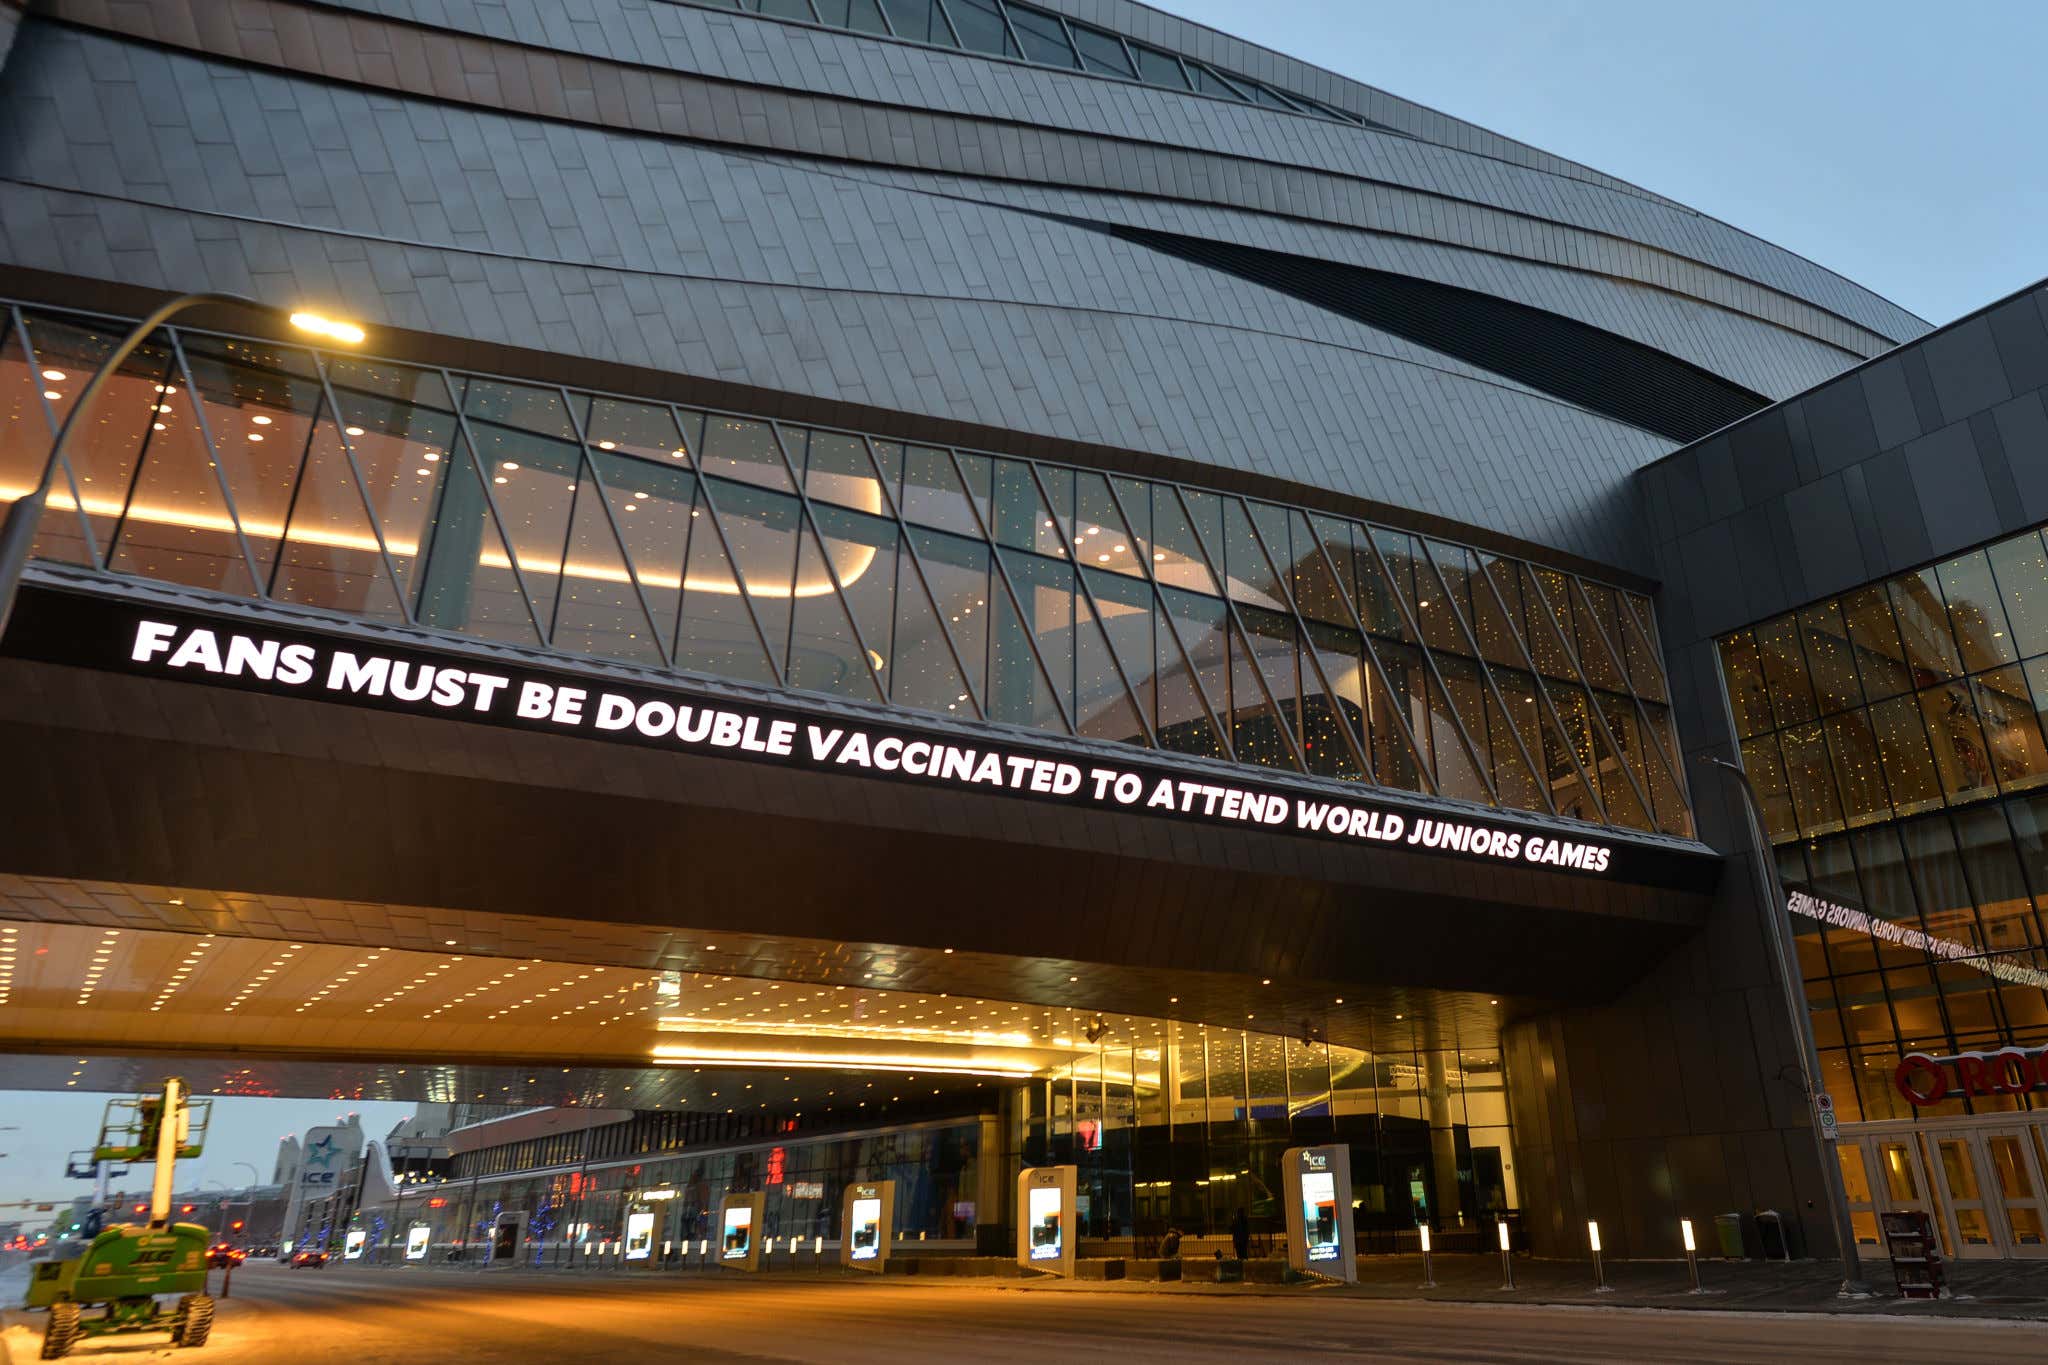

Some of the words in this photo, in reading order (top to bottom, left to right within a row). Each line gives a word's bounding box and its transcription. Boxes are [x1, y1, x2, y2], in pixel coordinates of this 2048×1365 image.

[131, 620, 316, 685] FANS
[326, 651, 509, 712] MUST
[516, 681, 587, 725] BE
[594, 693, 797, 756] DOUBLE
[807, 725, 1082, 796] VACCINATED
[1090, 768, 1143, 804] TO
[1147, 778, 1289, 825] ATTEND
[1297, 800, 1405, 842] WORLD
[1407, 818, 1522, 860] JUNIORS
[1524, 837, 1611, 872] GAMES
[1957, 1052, 2048, 1098] RO
